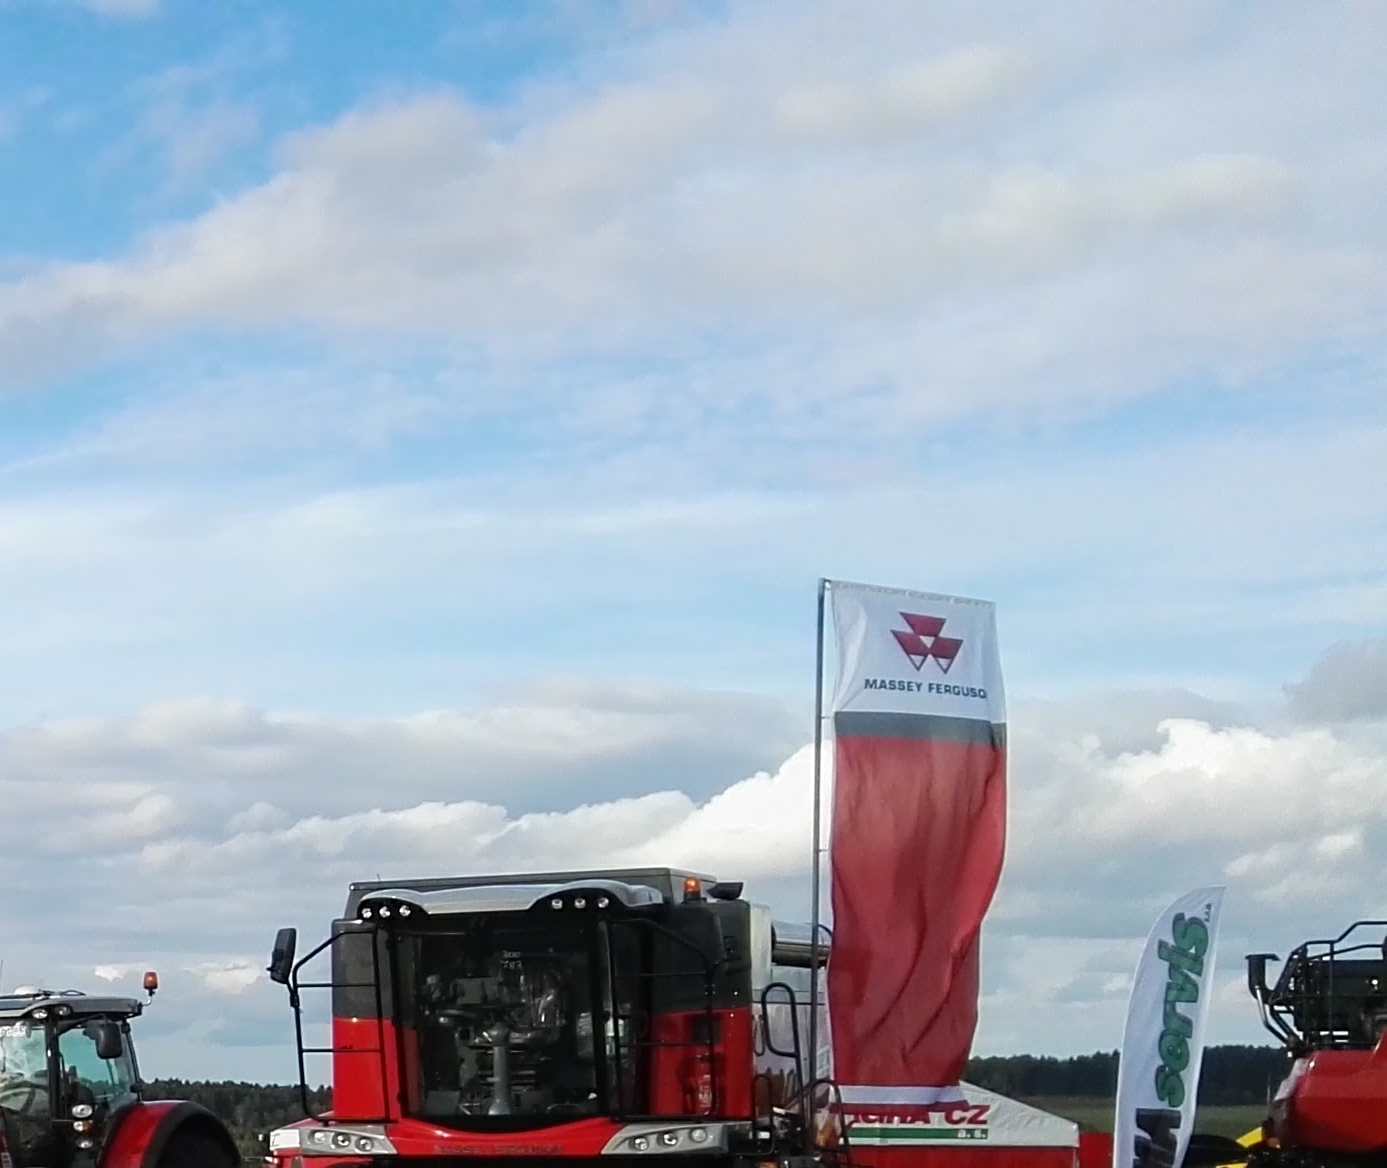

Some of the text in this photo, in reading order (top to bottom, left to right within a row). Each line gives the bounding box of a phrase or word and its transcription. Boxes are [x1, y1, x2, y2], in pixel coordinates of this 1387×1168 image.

[864, 678, 988, 699] MASSEY FERGUSO
[944, 1101, 990, 1124] CZ
